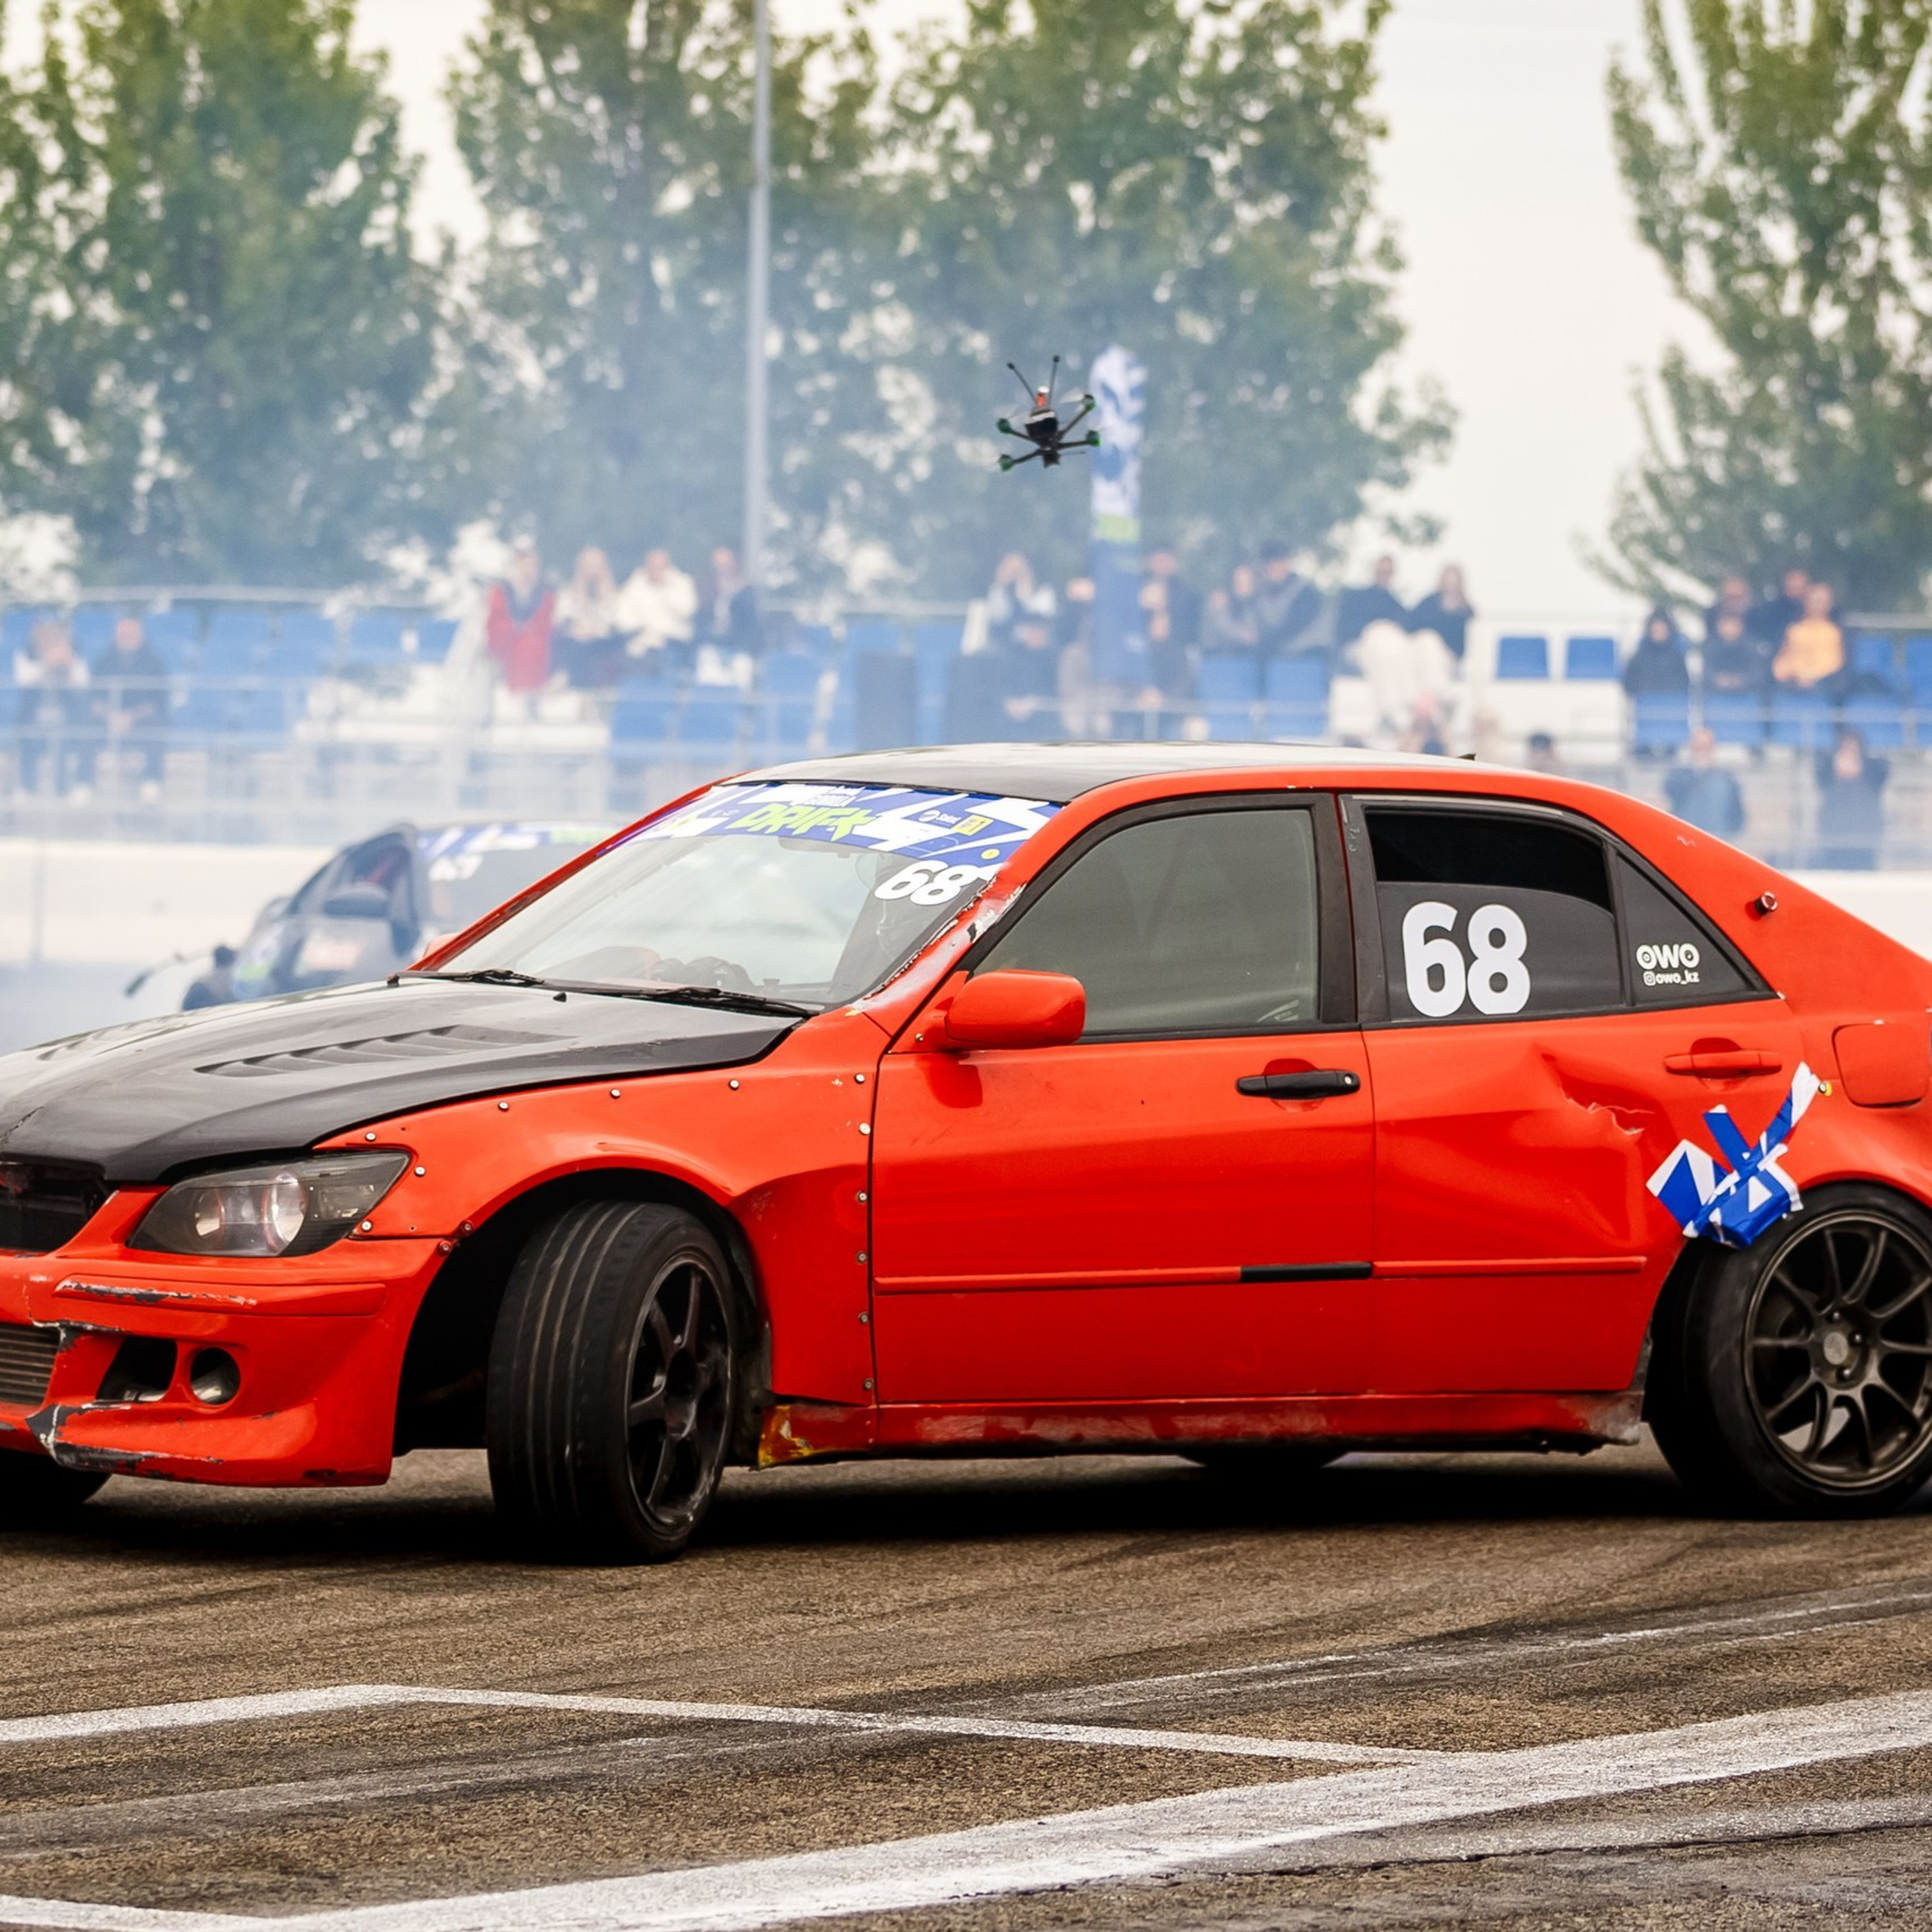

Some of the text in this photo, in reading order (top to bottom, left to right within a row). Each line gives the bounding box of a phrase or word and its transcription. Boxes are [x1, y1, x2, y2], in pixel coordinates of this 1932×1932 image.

[726, 804, 876, 841] DRIFT
[875, 860, 980, 906] 68
[1401, 900, 1531, 1018] 68
[1636, 943, 1700, 970] OWO
